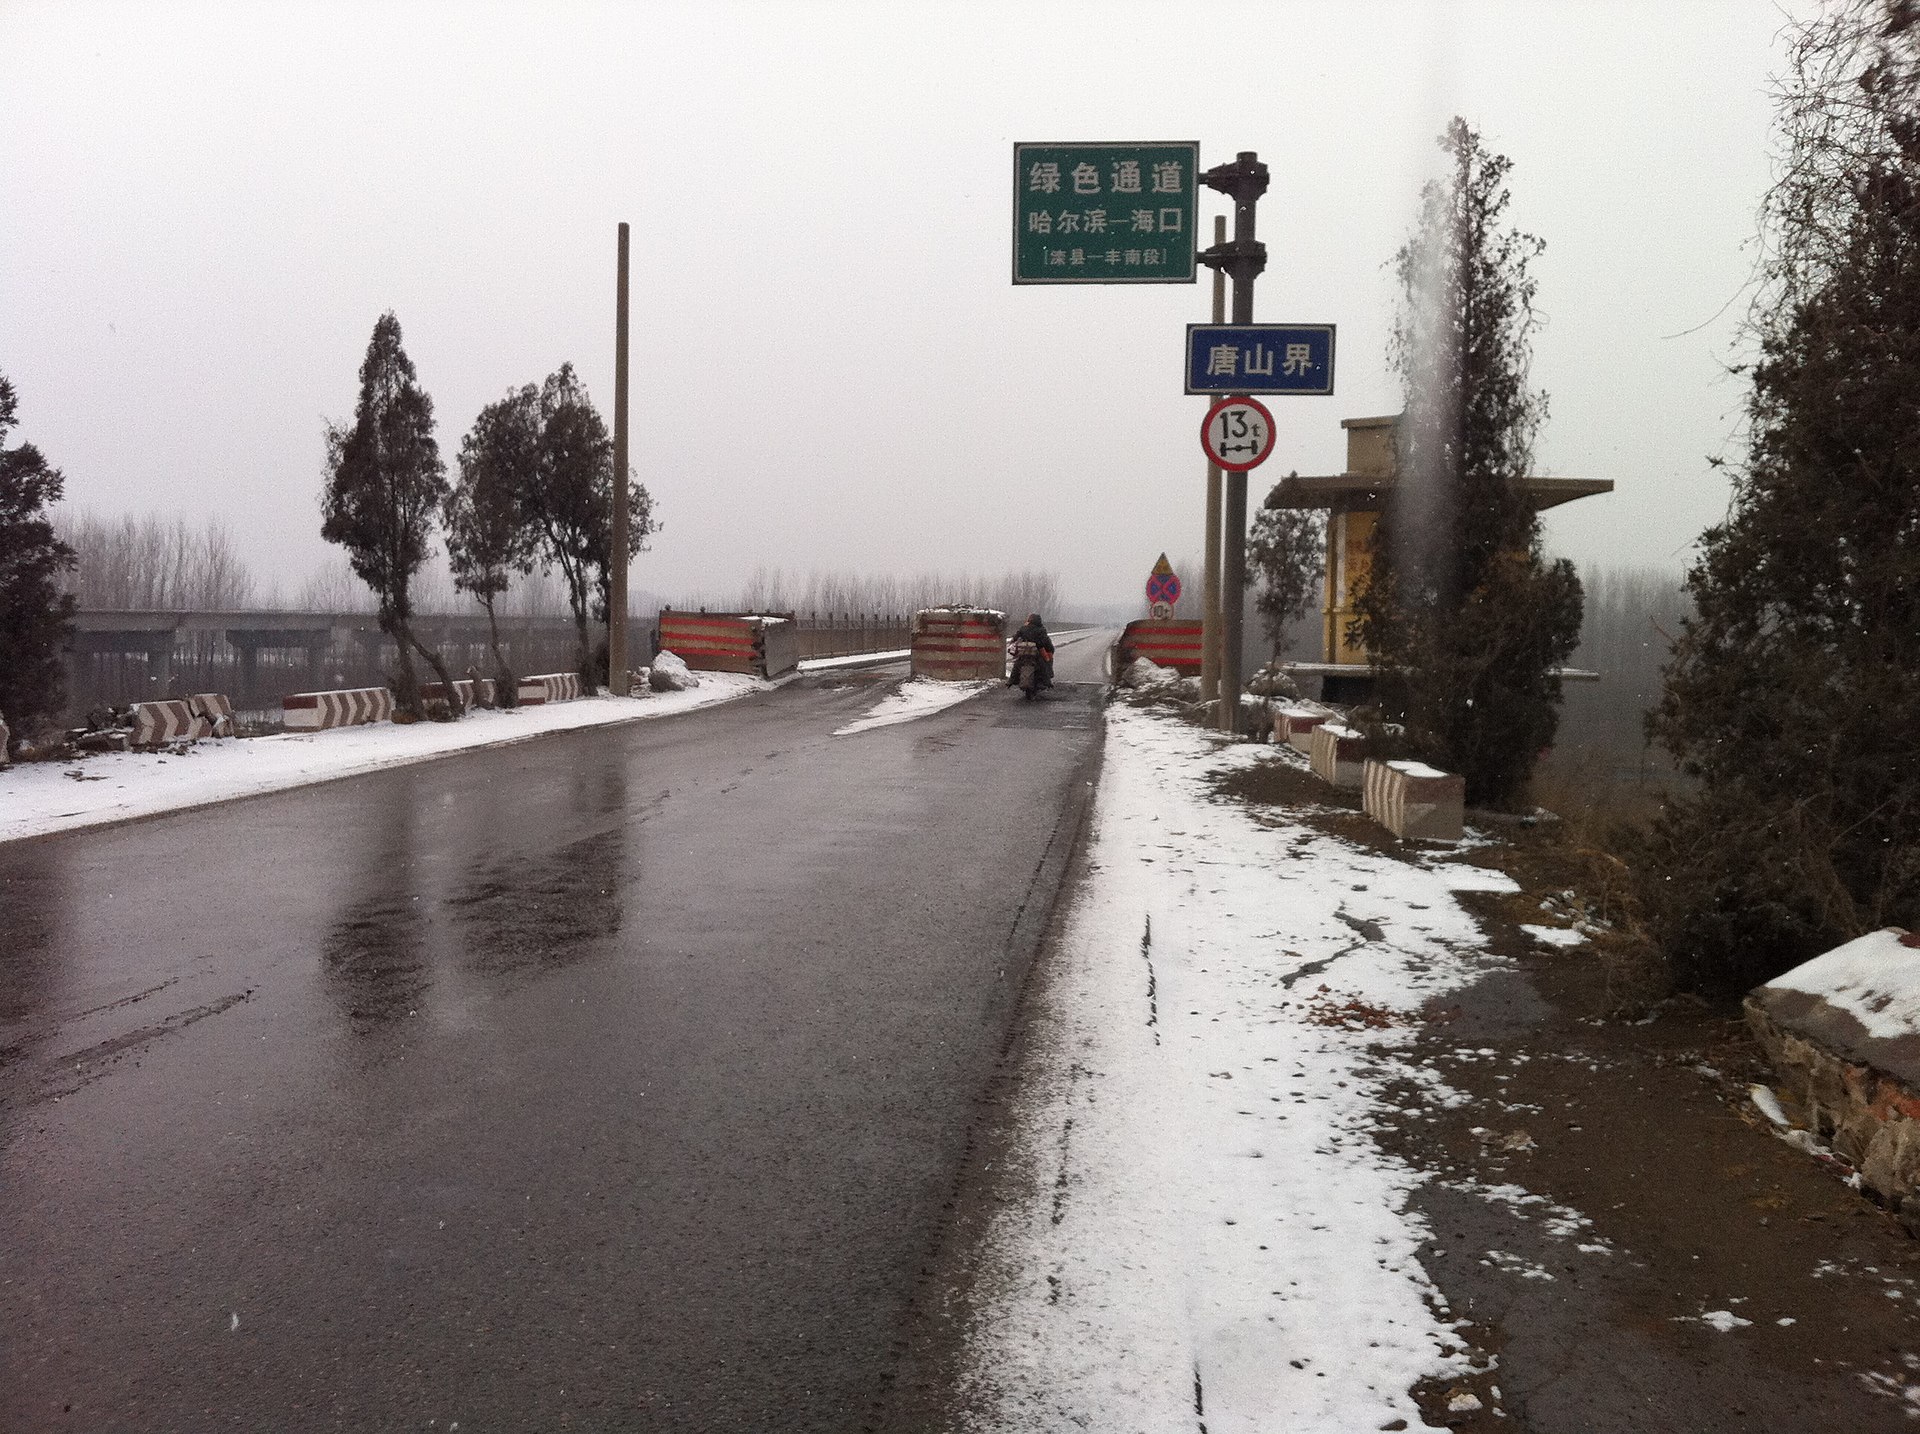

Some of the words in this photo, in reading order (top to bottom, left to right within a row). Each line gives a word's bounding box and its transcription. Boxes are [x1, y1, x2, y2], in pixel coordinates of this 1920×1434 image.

[1029, 161, 1183, 194] 绿色通道
[1206, 343, 1314, 377] 唐山界
